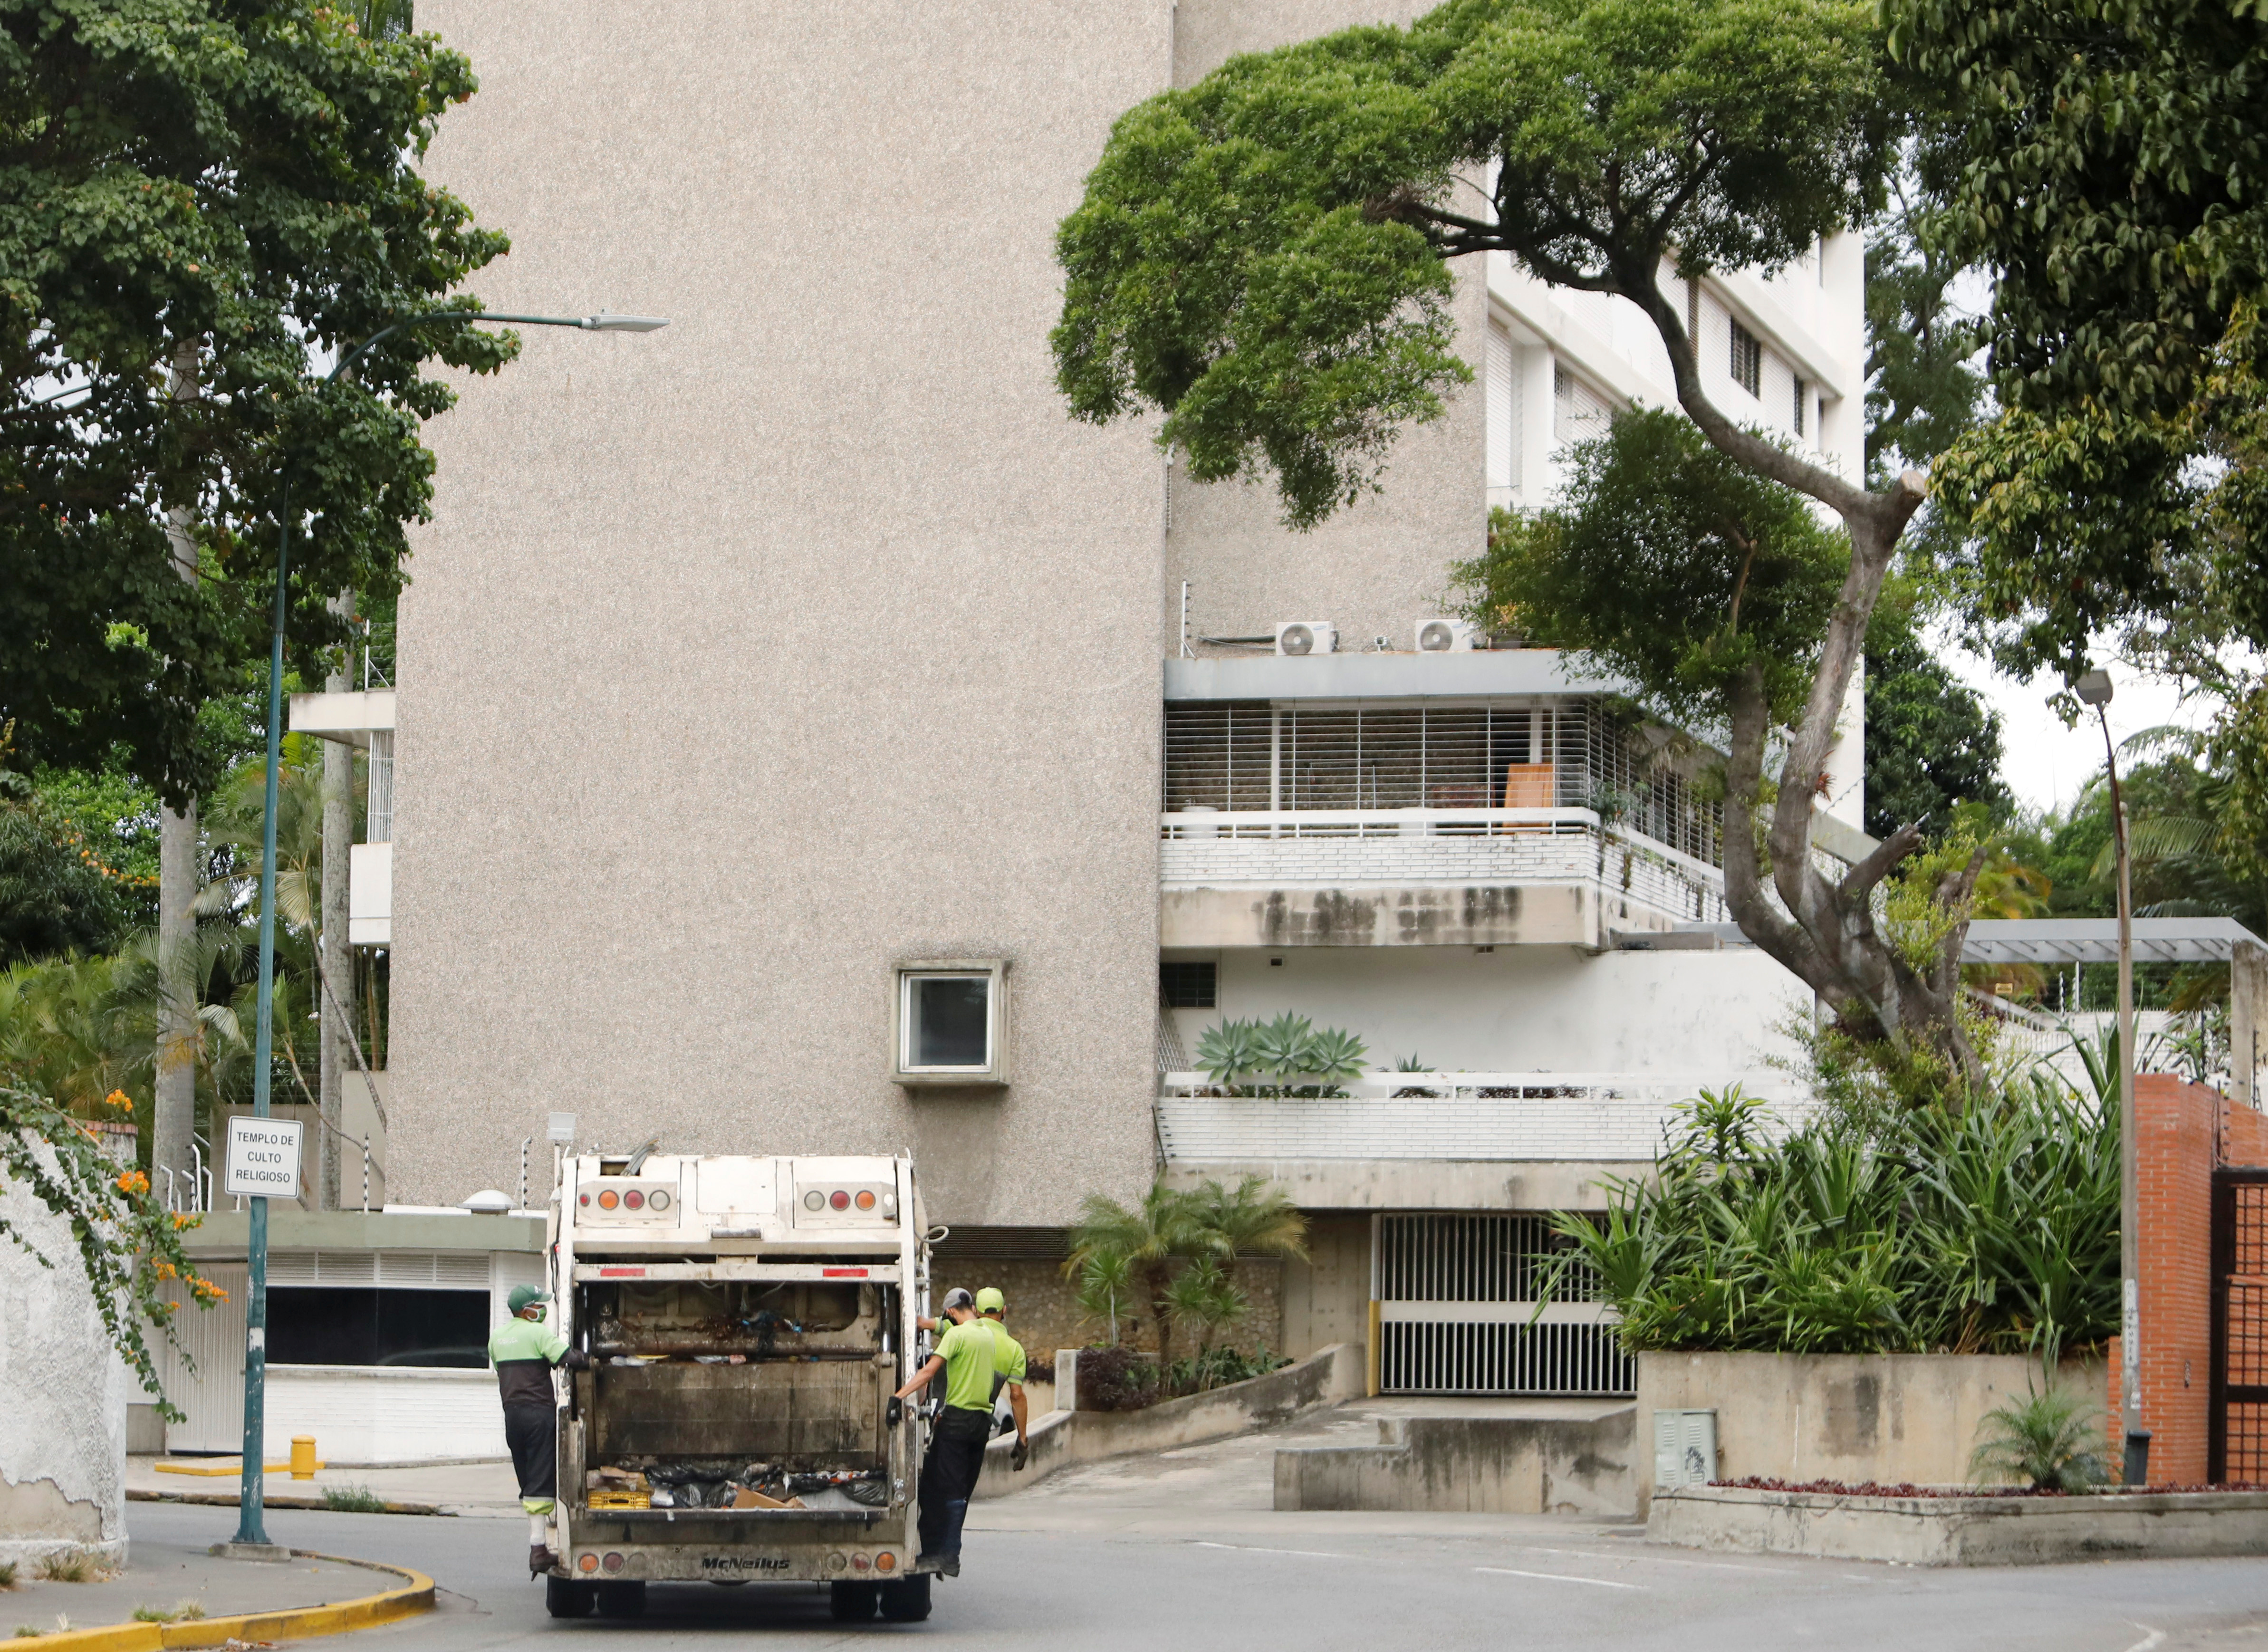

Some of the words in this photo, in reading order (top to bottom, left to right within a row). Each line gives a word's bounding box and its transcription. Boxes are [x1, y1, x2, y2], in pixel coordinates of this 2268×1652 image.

[237, 1132, 278, 1144] TEMPLO
[281, 1135, 294, 1145] DE
[248, 1151, 281, 1163] CULTO
[236, 1169, 290, 1183] RELIGIOSO
[702, 1557, 790, 1569] McNeilus
